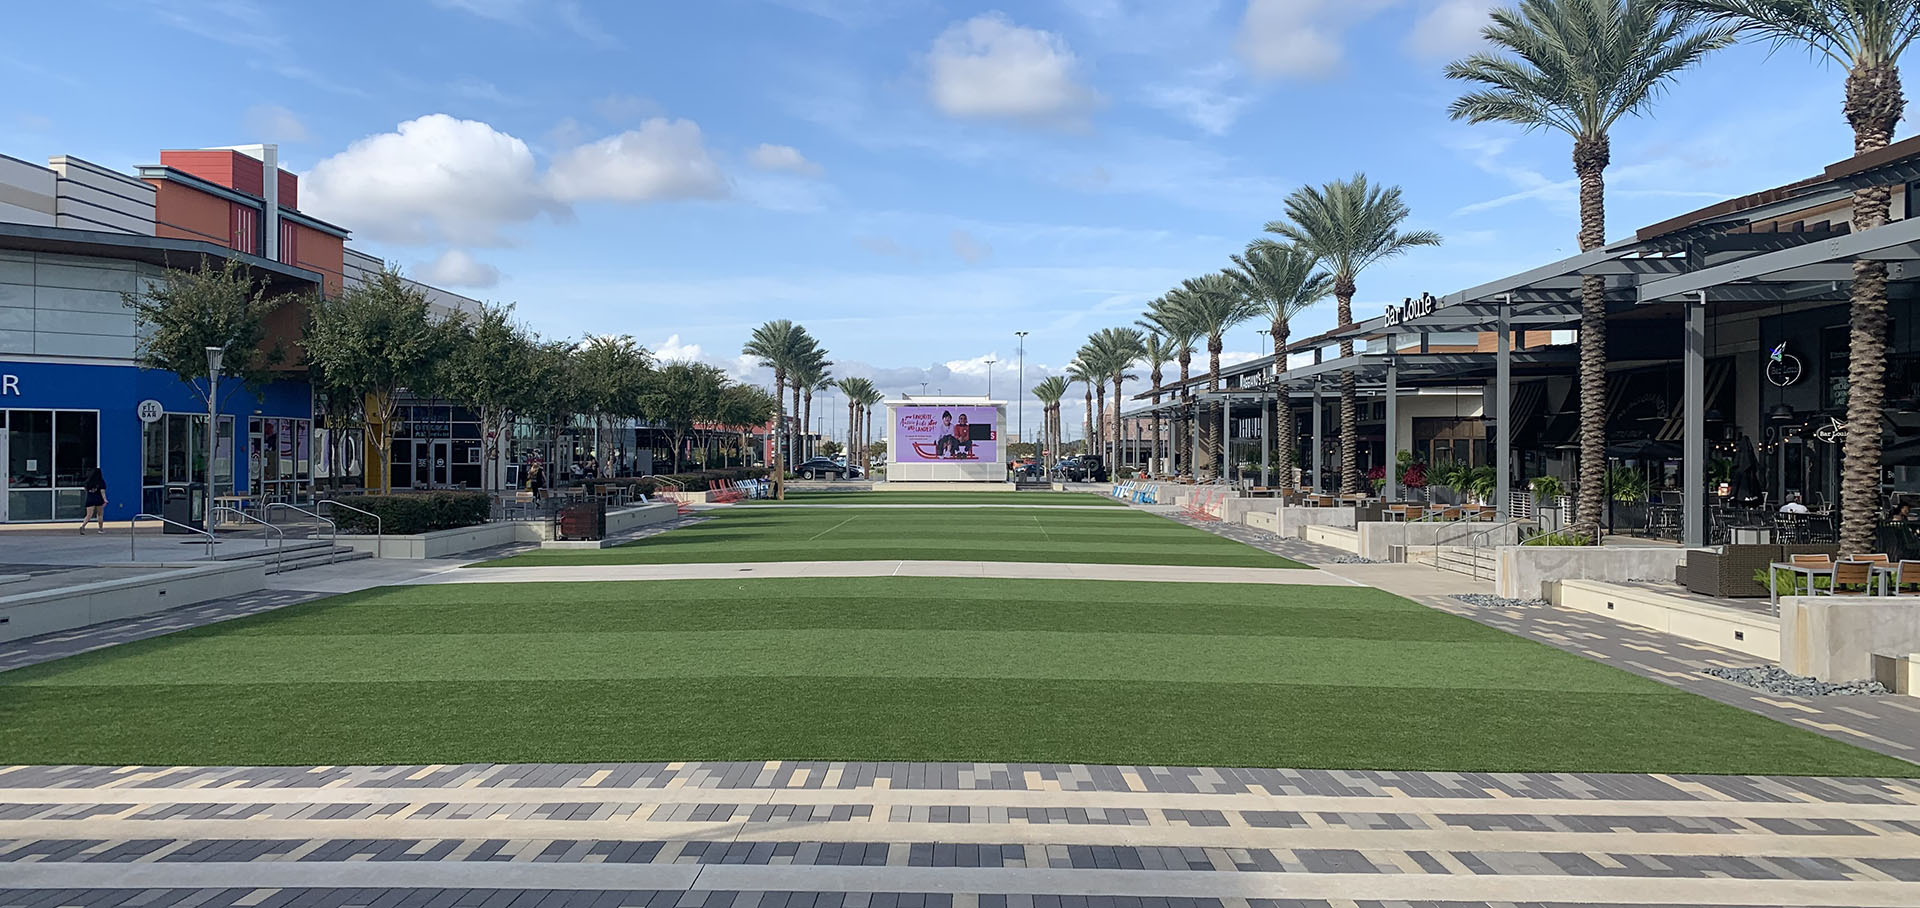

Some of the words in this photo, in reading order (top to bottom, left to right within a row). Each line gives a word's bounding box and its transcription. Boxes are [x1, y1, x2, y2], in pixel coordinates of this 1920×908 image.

[1384, 305, 1403, 328] Bar
[1403, 292, 1434, 322] Louie
[2, 374, 20, 396] R
[142, 403, 155, 411] FIT
